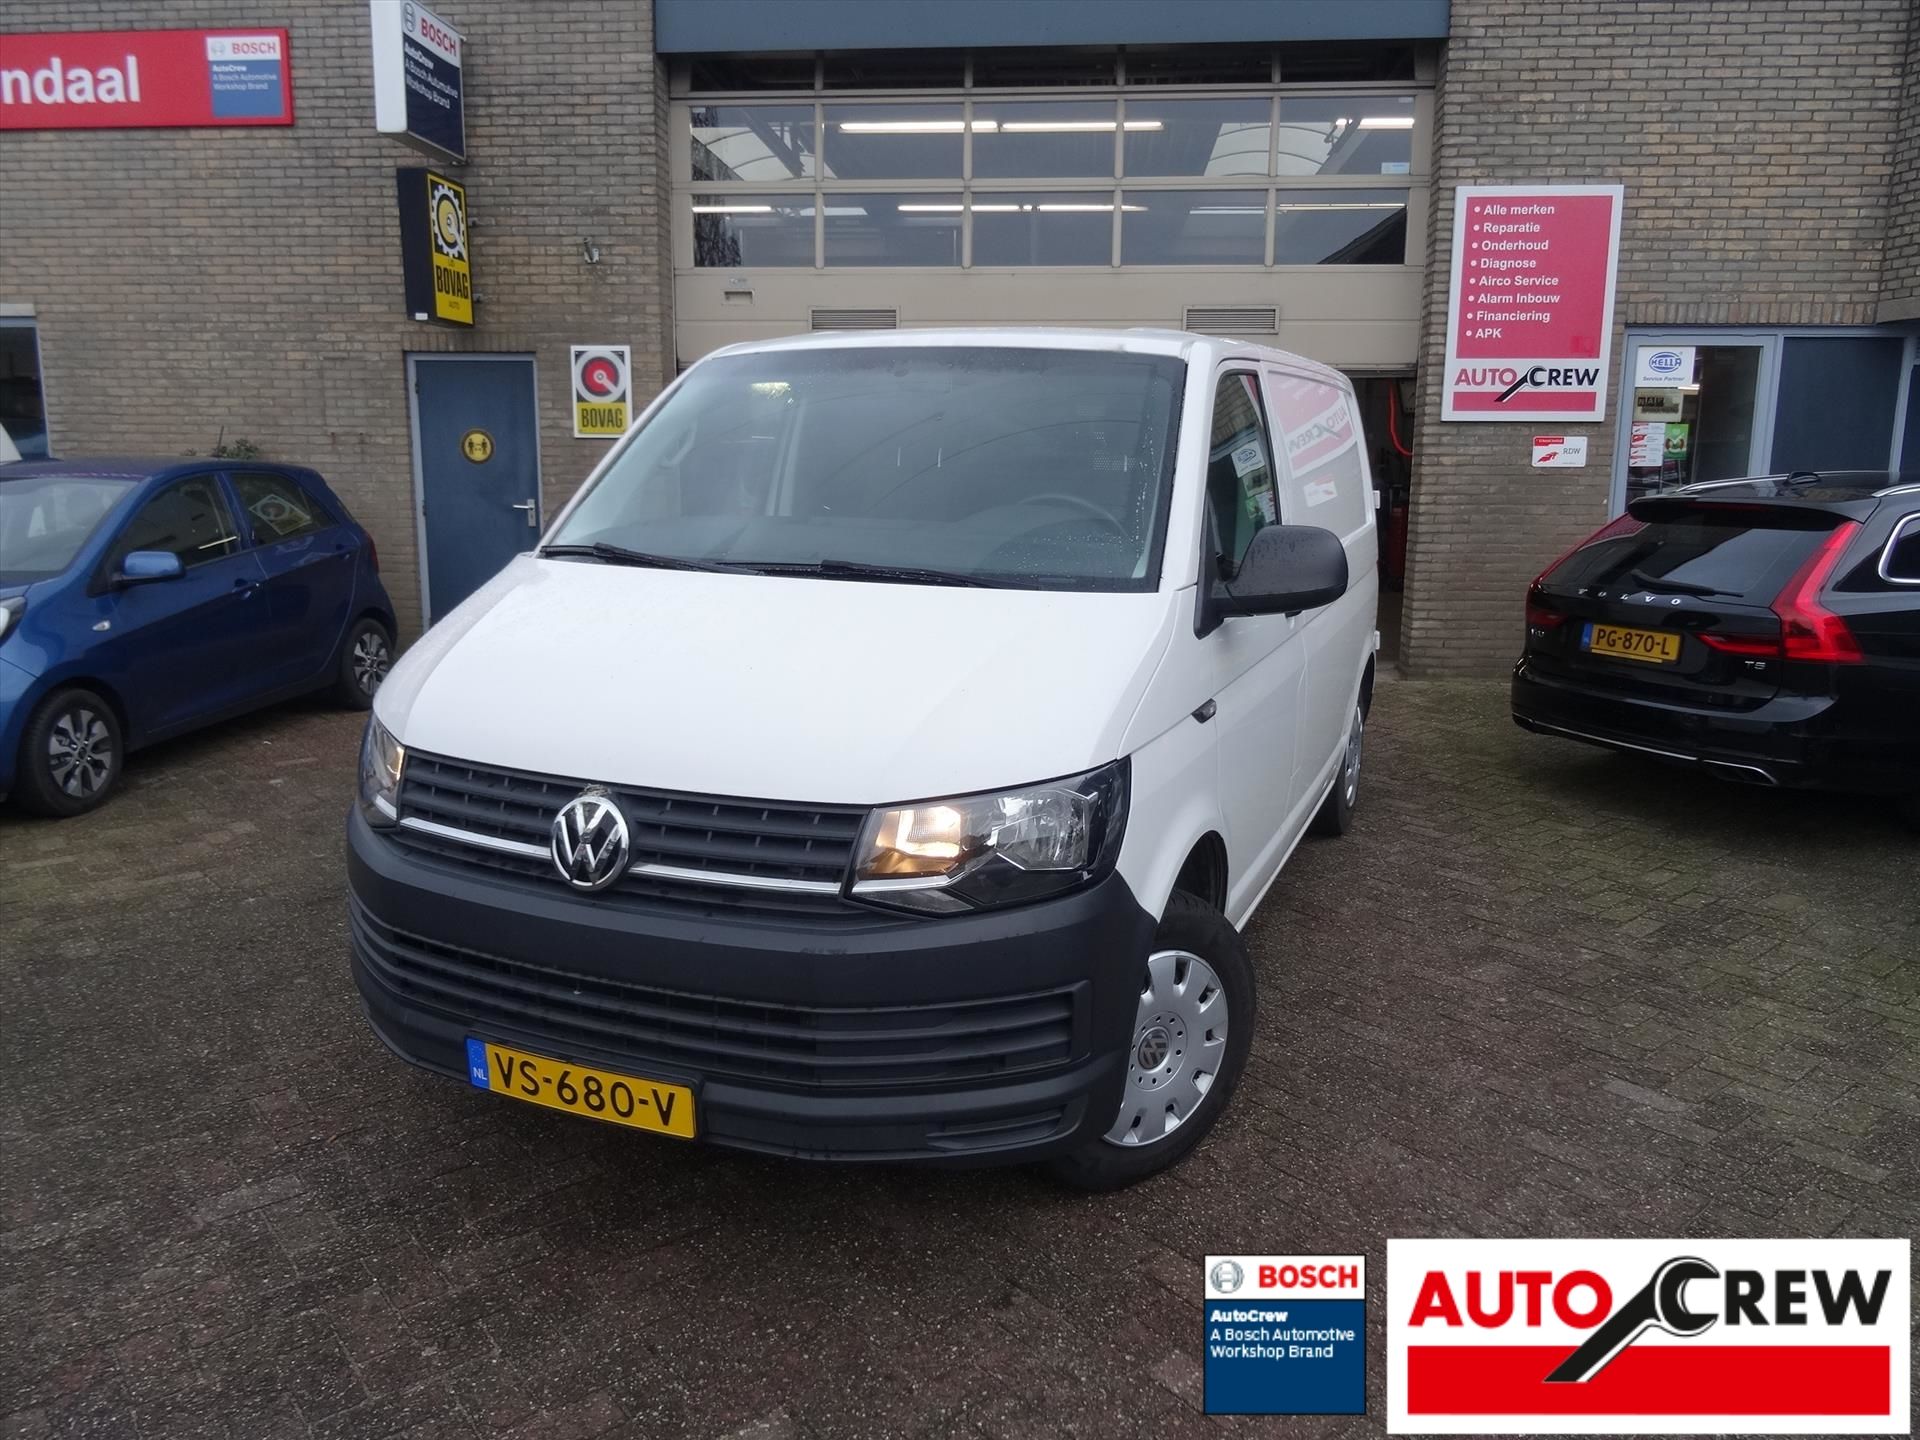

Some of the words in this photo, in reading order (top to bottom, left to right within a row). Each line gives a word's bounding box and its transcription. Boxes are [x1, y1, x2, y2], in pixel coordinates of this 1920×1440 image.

[421, 17, 457, 57] BOSCH
[232, 42, 276, 54] BOSCH
[0, 54, 141, 105] ndaal
[1484, 205, 1507, 215] Alle
[1510, 205, 1555, 215] merken
[1483, 223, 1541, 234] Reparatie
[1481, 240, 1549, 251] Onderhoud
[1480, 258, 1537, 270] Diagnose
[436, 265, 469, 299] BOVAG
[1479, 276, 1511, 286] Airco
[1514, 275, 1559, 286] Service
[1477, 293, 1513, 304] Alarm
[1516, 293, 1560, 304] Inbouw
[1476, 310, 1551, 323] Financiering
[1475, 328, 1502, 339] APK
[581, 408, 623, 428] BOVAG
[1562, 447, 1581, 455] RDW
[1578, 588, 1681, 606] VOLVO
[1596, 628, 1670, 656] PG-870-L
[472, 1067, 488, 1081] NL
[494, 1052, 675, 1126] VS-680-V
